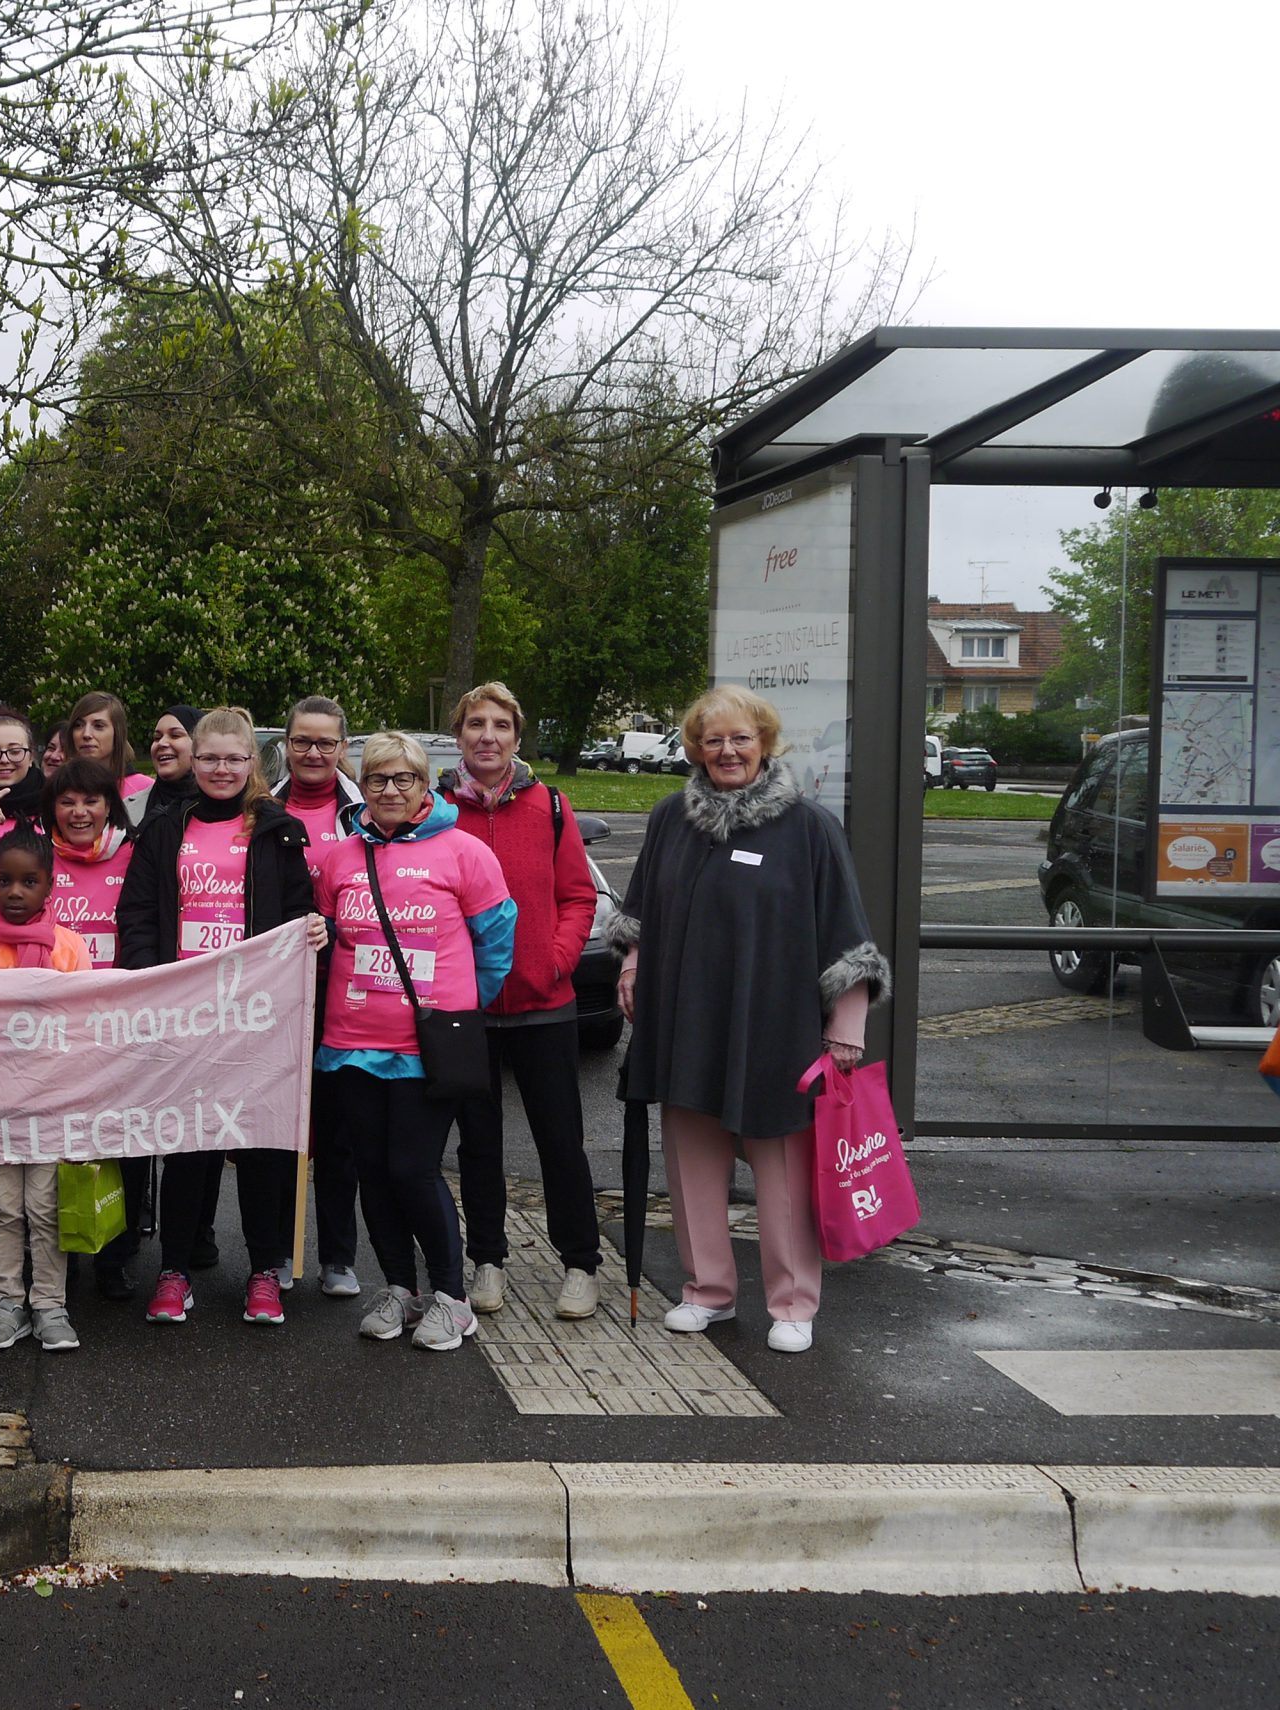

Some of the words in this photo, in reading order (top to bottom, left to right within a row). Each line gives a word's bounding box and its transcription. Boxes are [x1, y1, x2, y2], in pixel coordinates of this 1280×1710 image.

[764, 545, 798, 582] free
[726, 639, 741, 661] LA
[742, 633, 772, 659] FIBRE
[748, 667, 777, 690] CHEZ
[781, 662, 810, 687] VOUS
[369, 949, 415, 976] 284
[2, 1010, 71, 1052] en
